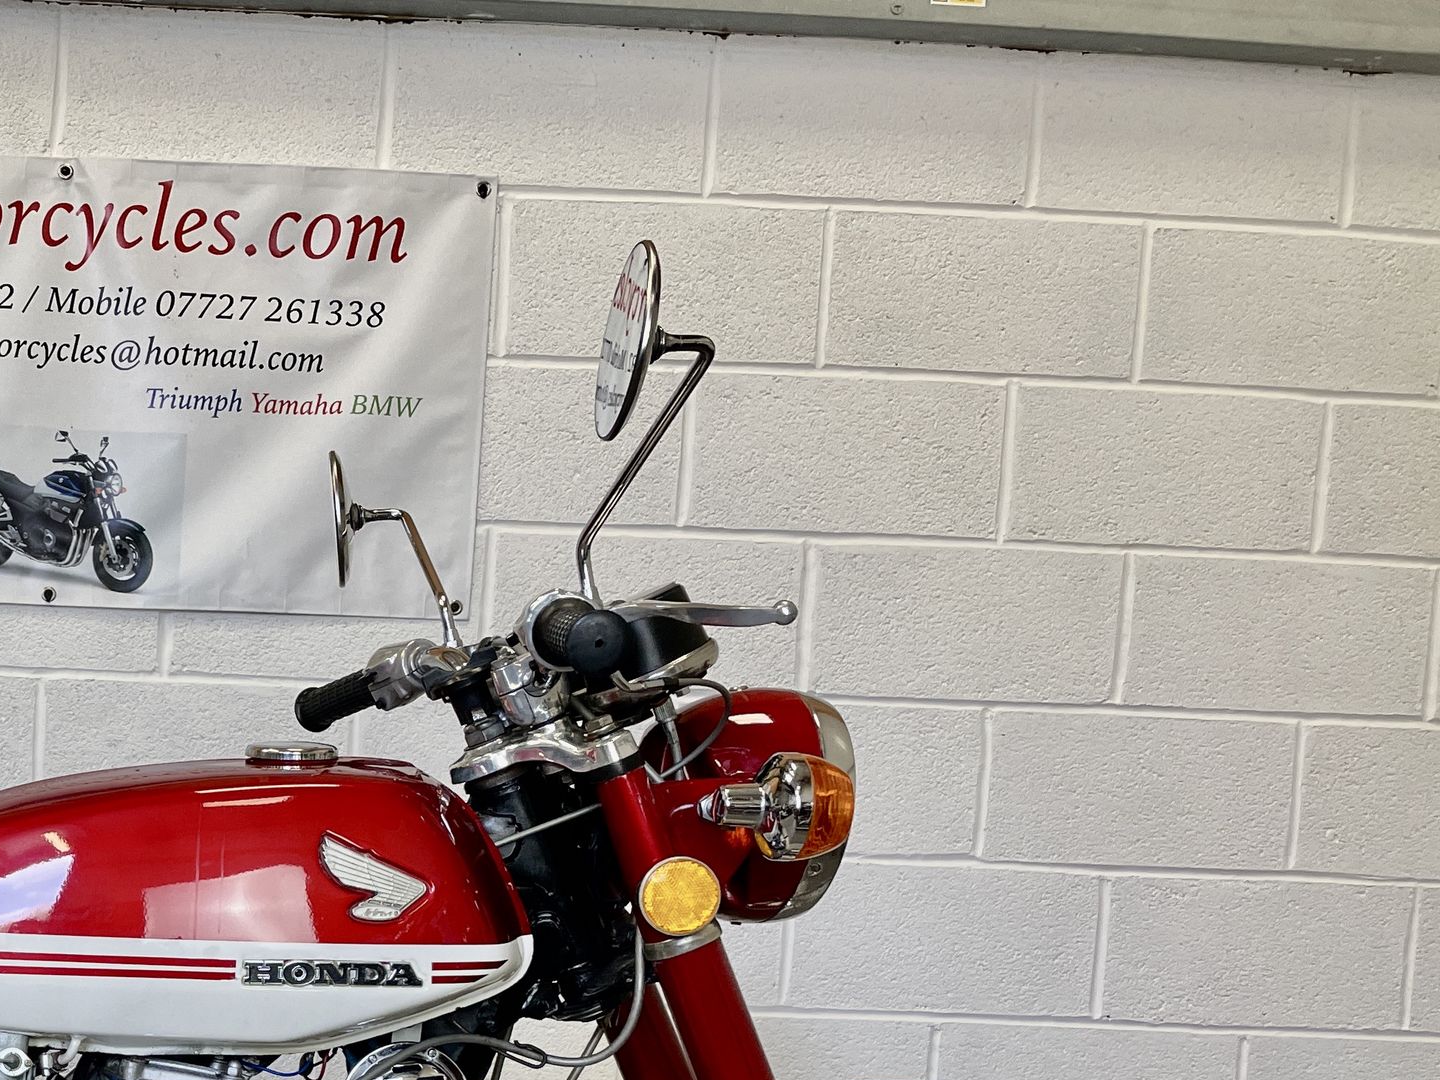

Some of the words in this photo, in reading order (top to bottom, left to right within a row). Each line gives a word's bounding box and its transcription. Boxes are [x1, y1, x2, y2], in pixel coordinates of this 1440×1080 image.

[22, 285, 39, 313] /
[45, 286, 146, 316] Mobile
[156, 290, 257, 320] 07727
[264, 297, 385, 328] 261338
[146, 387, 242, 418] Triumph
[252, 393, 343, 415] Yamaha
[350, 395, 423, 417] BMW
[241, 959, 423, 987] HONDA
